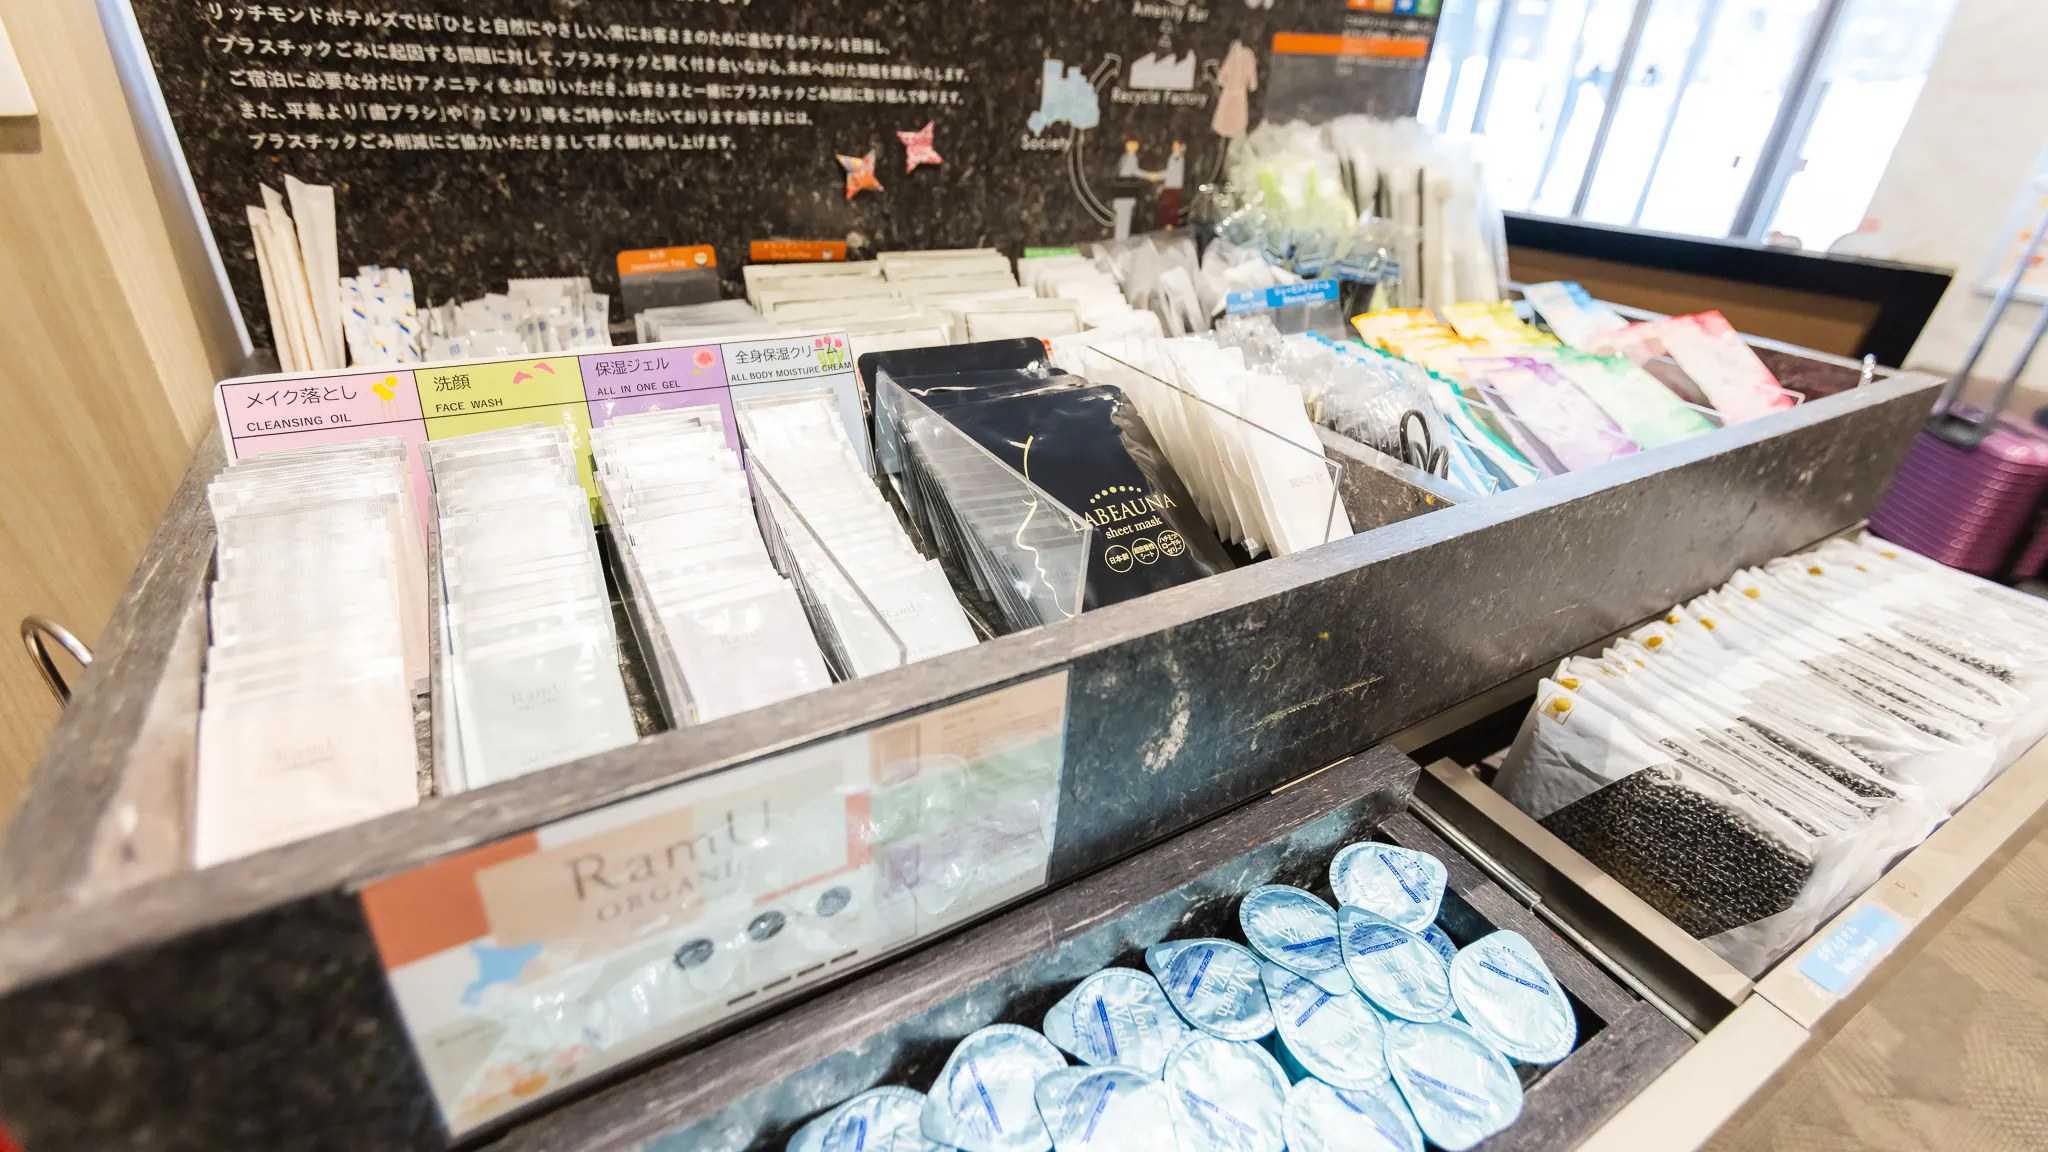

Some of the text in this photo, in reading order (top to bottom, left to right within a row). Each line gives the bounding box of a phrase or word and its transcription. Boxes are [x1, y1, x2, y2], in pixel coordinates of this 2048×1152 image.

[1131, 0, 1210, 24] Amenity Bar
[1111, 86, 1208, 110] Recycle Factory
[248, 132, 738, 150] プラスチックごみ削減にご協力いただきまして厚く御礼申し上げます。
[1020, 133, 1071, 154] Society
[735, 343, 838, 365] 全身保湿クリーム
[595, 357, 670, 377] 保湿ジェル
[731, 361, 852, 382] ALL BODY MOISTURE CREAM
[433, 374, 472, 392] 洗顔
[597, 380, 681, 396] ALL IN ONE GEL
[246, 385, 357, 409] メイク落とし
[435, 397, 503, 412] FACE WASH
[246, 413, 352, 432] CLEANSING OIL
[1067, 493, 1178, 533] LABEAUNA
[1105, 515, 1163, 540] sheet mask
[1109, 552, 1130, 565] 日本製
[1141, 550, 1155, 560] シート
[1274, 922, 1326, 944] Wash
[1197, 962, 1236, 998] Wash
[1214, 963, 1260, 1018] Mouth
